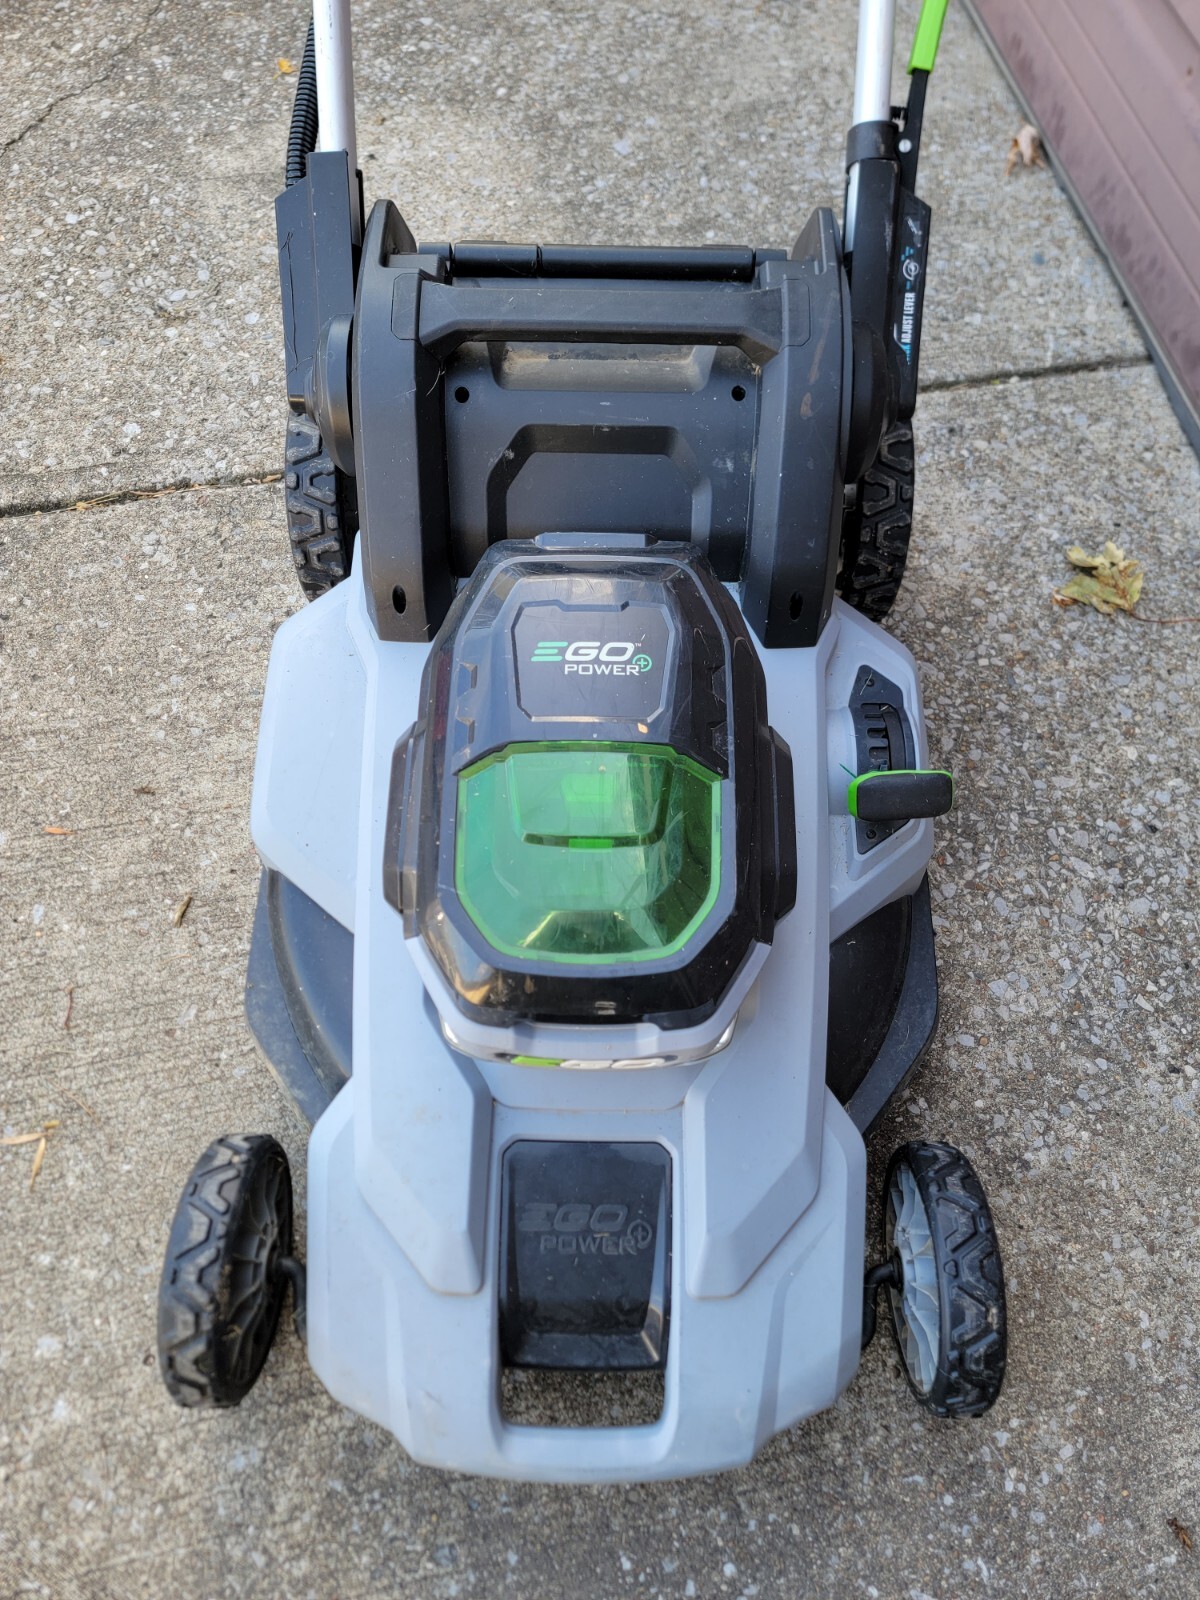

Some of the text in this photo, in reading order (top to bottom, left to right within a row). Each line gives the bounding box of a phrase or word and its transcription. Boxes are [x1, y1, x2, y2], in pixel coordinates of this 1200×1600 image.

[903, 292, 916, 315] LEVER
[901, 315, 914, 344] ADJUST
[531, 641, 635, 662] EGO
[564, 664, 640, 676] POWER
[518, 1203, 628, 1231] EGO
[540, 1235, 637, 1255] POWER
